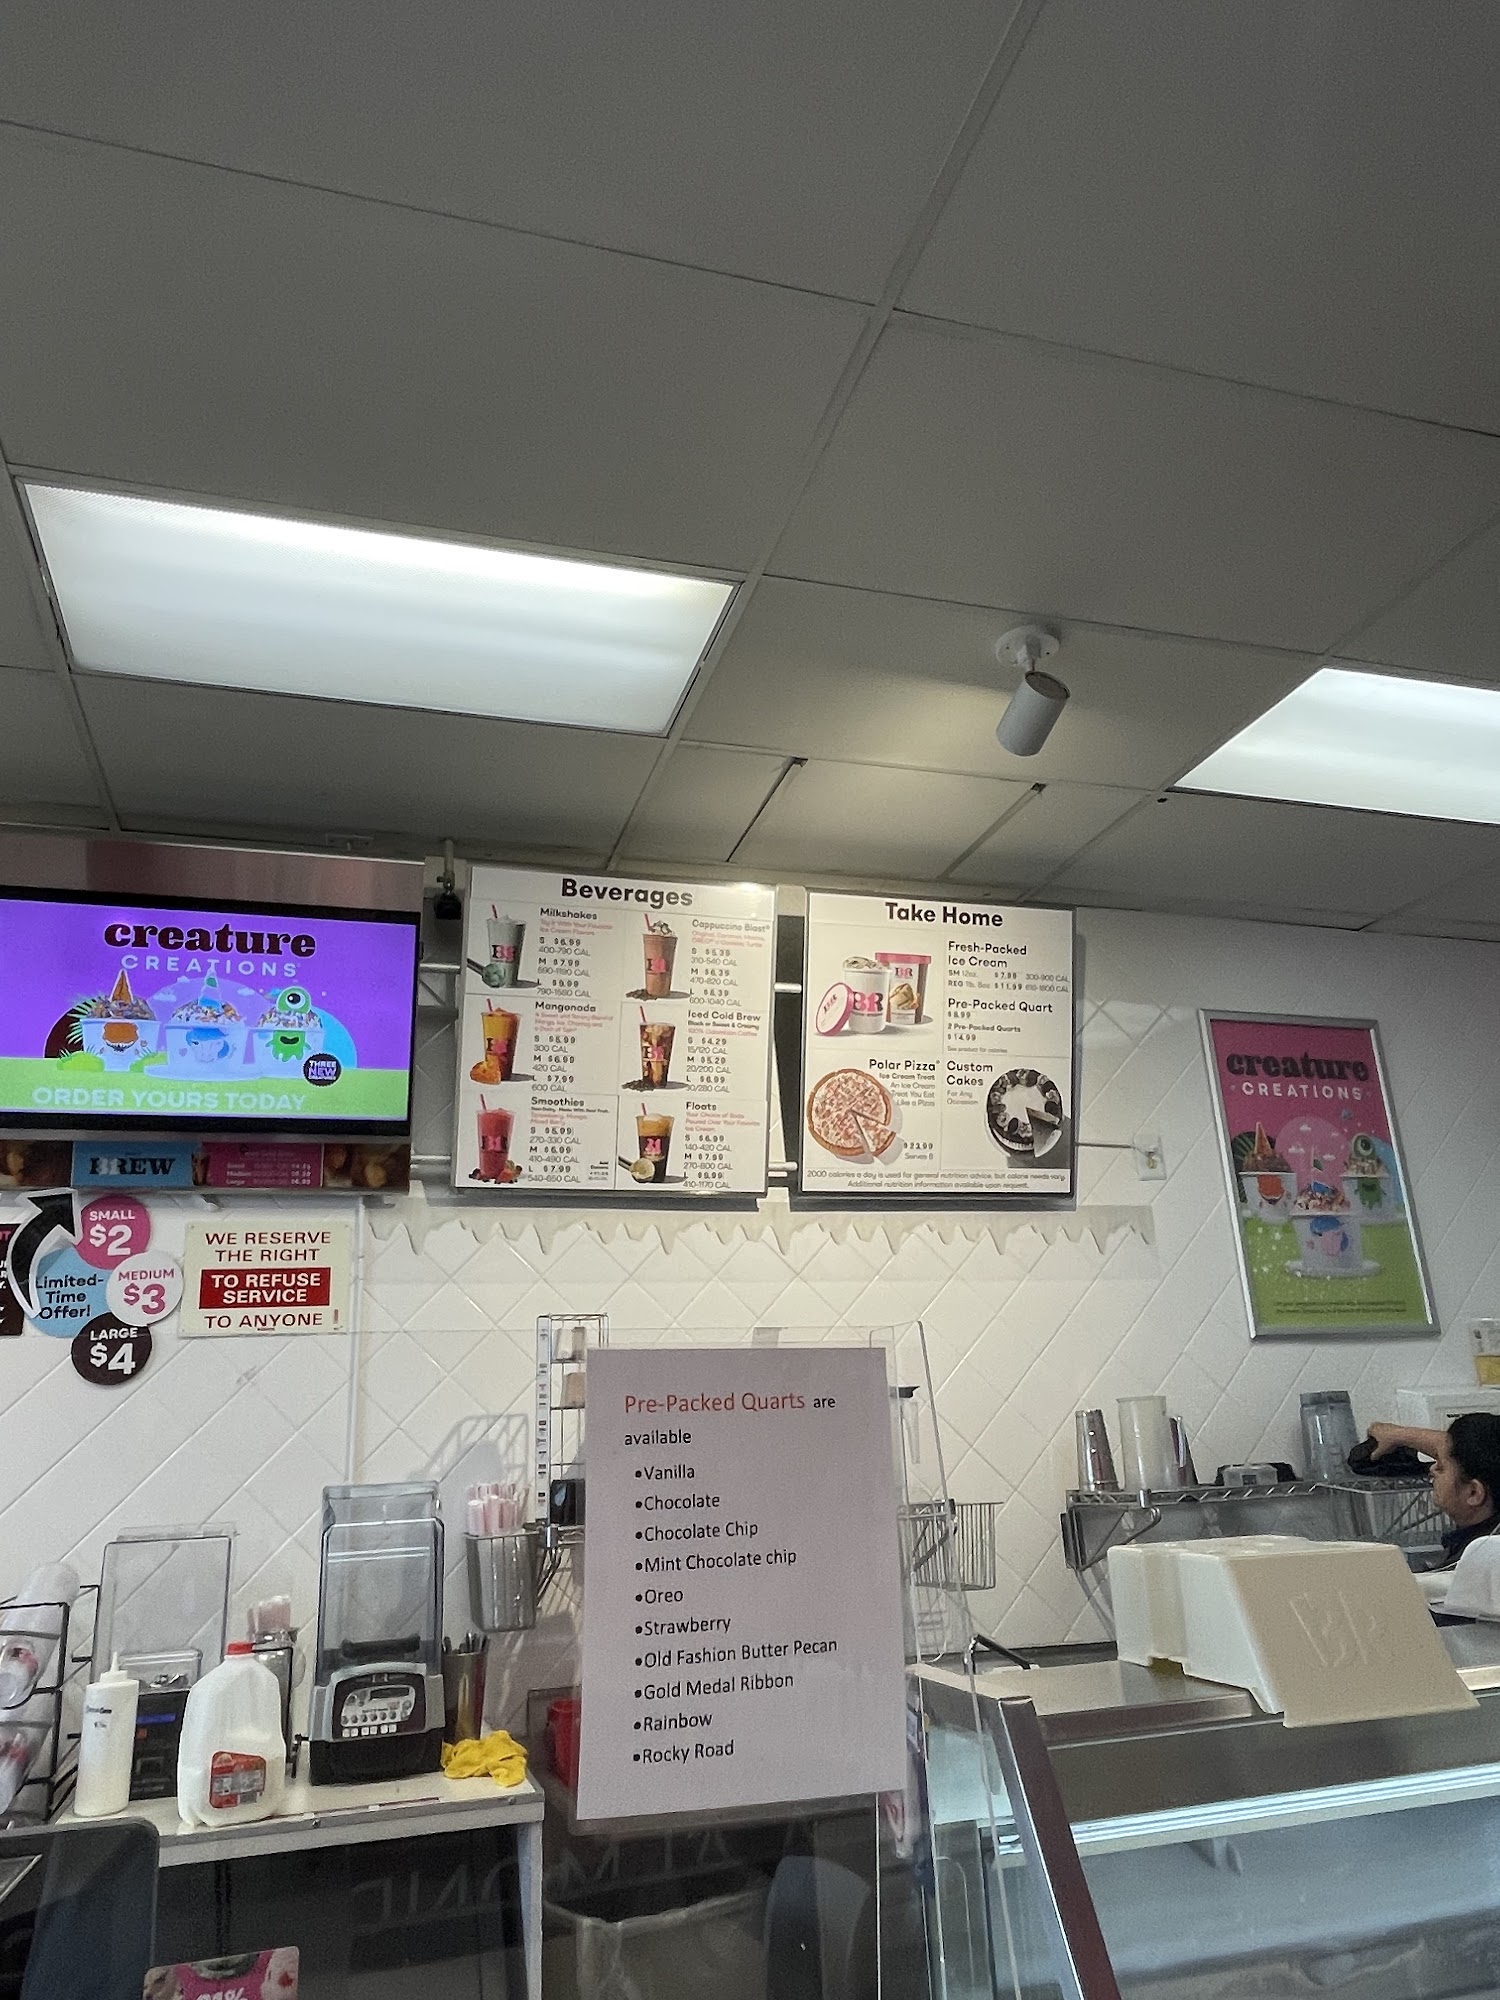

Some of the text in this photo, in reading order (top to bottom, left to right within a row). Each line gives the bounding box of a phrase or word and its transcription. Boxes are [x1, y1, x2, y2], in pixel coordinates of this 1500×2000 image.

[562, 878, 692, 909] Beverages
[540, 908, 597, 920] Milkshakes
[885, 902, 1004, 926] Take Home
[692, 920, 742, 931] Cappuccino
[104, 922, 316, 958] creature
[949, 941, 1027, 955] Fresh-Packed
[120, 954, 297, 978] CREATIONS
[949, 955, 1008, 968] Ice Cream
[574, 969, 590, 977] CAL
[535, 1002, 596, 1013] Mangonada
[949, 998, 1053, 1013] Pre-Packed Quart
[688, 1010, 761, 1021] Iced Cold Brew
[308, 1068, 336, 1076] NEW
[870, 1059, 901, 1070] Polar
[947, 1060, 993, 1072] Custom
[1226, 1052, 1370, 1082] creature
[947, 1075, 983, 1086] Cakes
[32, 1086, 306, 1112] ORDER YOURS TODAY
[1241, 1081, 1362, 1101] CREATIONS
[531, 1097, 584, 1107] Smoothies
[686, 1102, 716, 1111] Floats
[90, 1158, 176, 1175] BREW
[89, 1210, 135, 1222] SMALL
[89, 1224, 132, 1256] $2
[205, 1231, 331, 1245] WE RESERVE
[215, 1248, 320, 1262] THE RIGHT
[36, 1274, 104, 1289] Limited-
[118, 1268, 175, 1281] MEDIUM
[211, 1272, 321, 1288] TO REFUSE
[46, 1291, 86, 1304] Time
[124, 1283, 166, 1315] $3
[223, 1289, 307, 1304] SERVICE
[39, 1304, 91, 1320] Offer!
[204, 1315, 231, 1329] TO
[239, 1313, 323, 1327] ANYONE
[90, 1327, 138, 1341] LARGE
[90, 1342, 136, 1375] $4
[624, 1392, 836, 1414] Pre-Packed Quarts are
[624, 1429, 692, 1446] available
[644, 1464, 695, 1480] Vanilla
[644, 1493, 720, 1511] Chocolate
[644, 1521, 759, 1542] Chocolate Chip
[644, 1549, 797, 1572] Mint Chocolate chip
[644, 1588, 684, 1604] Oreo
[644, 1616, 731, 1636] Strawberry
[644, 1640, 838, 1668] Old Fashion Butter Pecan
[644, 1673, 794, 1700] Gold Medal Ribbon
[643, 1713, 713, 1732] Rainbow
[642, 1740, 734, 1764] Rocky Road
